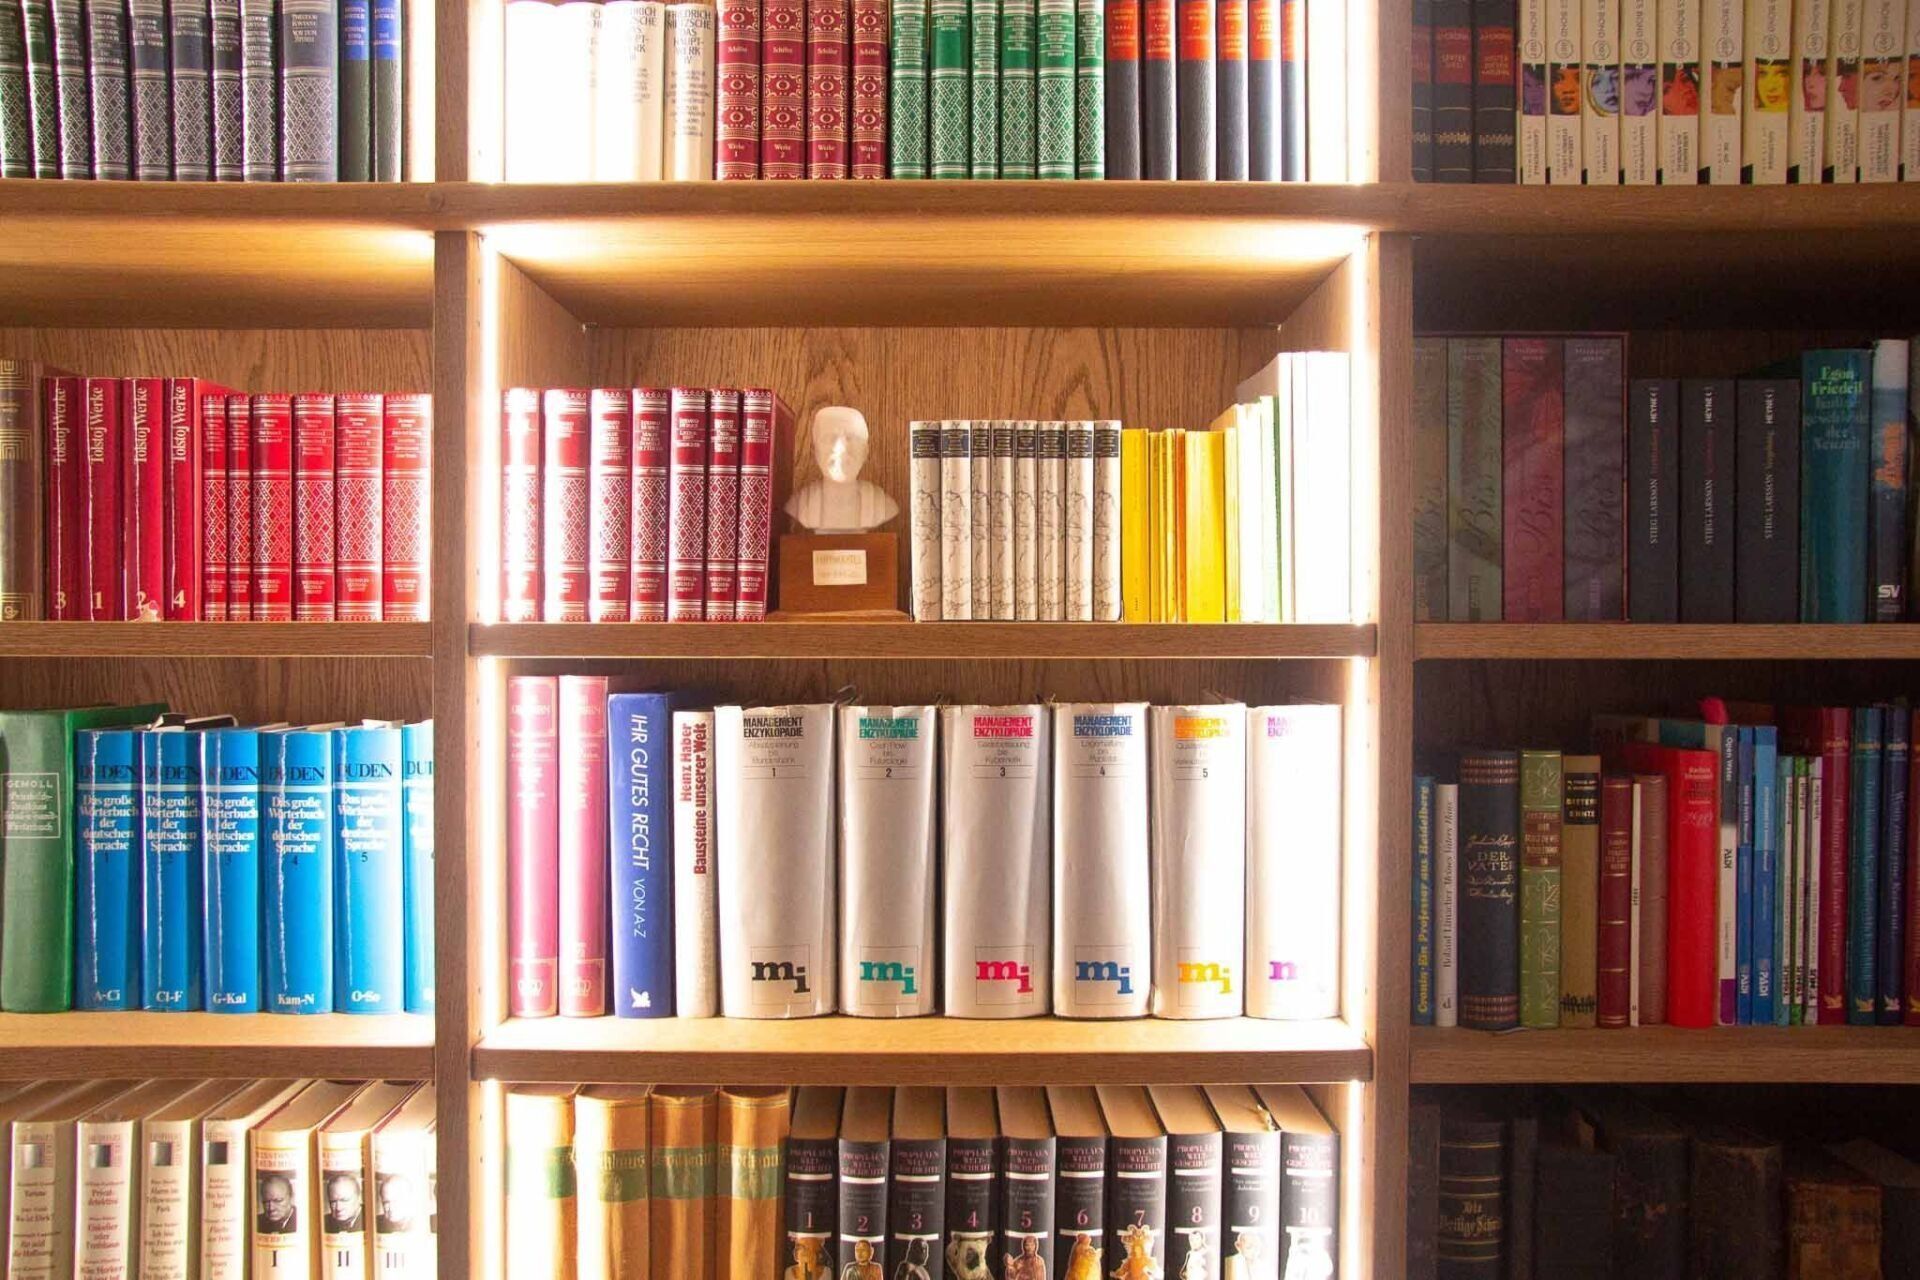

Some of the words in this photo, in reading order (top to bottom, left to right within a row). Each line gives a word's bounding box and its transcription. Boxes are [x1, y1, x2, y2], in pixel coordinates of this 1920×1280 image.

[1821, 366, 1855, 381] Egon
[1811, 381, 1863, 395] Friedell
[53, 388, 66, 425] Werke
[90, 387, 103, 425] Werke
[135, 388, 147, 425] Werke
[173, 386, 186, 424] Werke
[1650, 479, 1658, 517] LARSSON
[1704, 479, 1713, 518] LARSSON
[1765, 474, 1774, 512] LARSSON
[1650, 518, 1658, 544] STIEG
[1704, 519, 1713, 544] STIEG
[1765, 513, 1774, 539] STIEG
[55, 592, 66, 608] 3
[94, 592, 103, 608] 1
[135, 591, 147, 608] 2
[173, 590, 186, 607] 4
[631, 714, 647, 743] IHR
[744, 716, 803, 727] MANAGEMENT
[859, 718, 919, 728] MANAGEMENT
[974, 716, 1033, 727] MANAGEMENT
[1074, 716, 1133, 727] MANAGEMENT
[680, 723, 692, 763] Haber
[693, 723, 707, 753] Welt
[1725, 737, 1733, 758] Open
[338, 763, 393, 777] DUDEN
[631, 749, 648, 807] GUTES
[772, 768, 776, 777] 1
[886, 768, 892, 777] 2
[1000, 767, 1006, 777] 3
[1099, 767, 1105, 776] 4
[1203, 768, 1208, 778] 5
[1725, 759, 1733, 782] Water
[6, 779, 53, 789] GEMOLL
[680, 764, 691, 802] Heinz
[695, 755, 707, 810] unserer
[83, 795, 101, 805] Das
[103, 795, 133, 806] große
[147, 795, 165, 806] Das
[167, 796, 197, 807] große
[206, 796, 223, 807] Das
[225, 797, 255, 809] große
[272, 796, 289, 807] Das
[290, 797, 321, 809] große
[80, 806, 139, 818] Wörterbuch
[145, 807, 199, 818] Wörterbuch
[205, 808, 259, 819] Wörterbuch
[269, 808, 326, 819] Wörterbuch
[1418, 786, 1430, 854] Heidelberg
[99, 818, 117, 828] der
[162, 819, 180, 829] der
[221, 820, 238, 829] der
[288, 820, 304, 829] der
[83, 829, 134, 839] deutschen
[147, 830, 197, 840] deutschen
[205, 830, 255, 840] deutschen
[272, 830, 321, 840] deutschen
[632, 812, 649, 870] RECHT
[87, 840, 129, 852] Sprache
[151, 841, 192, 853] Sprache
[209, 842, 250, 853] Sprache
[275, 842, 316, 854] Sprache
[694, 811, 707, 875] Bausteine
[361, 852, 368, 862] 5
[1477, 852, 1509, 860] DER
[1420, 859, 1429, 880] aus
[633, 878, 645, 911] VON
[1418, 882, 1429, 941] Professor
[633, 912, 646, 938] A-Z
[1443, 936, 1452, 968] Roland
[751, 960, 810, 993] mi
[859, 960, 917, 994] mi
[975, 960, 1034, 994] mi
[1075, 960, 1133, 994] mi
[1740, 974, 1750, 994] PADI
[1759, 971, 1769, 997] PADI
[213, 991, 247, 1004] G-Kal
[278, 993, 315, 1004] Kam-N
[806, 1212, 812, 1228] 1
[912, 1213, 922, 1229] 3
[967, 1210, 979, 1227] 4
[1021, 1211, 1031, 1228] 5
[1077, 1208, 1088, 1225] 6
[1134, 1209, 1145, 1226] 7
[1191, 1206, 1202, 1223] 8
[1249, 1206, 1259, 1222] 9
[1300, 1207, 1319, 1223] 10
[858, 1216, 869, 1232] 2
[272, 1251, 278, 1267] I
[337, 1251, 350, 1267] II
